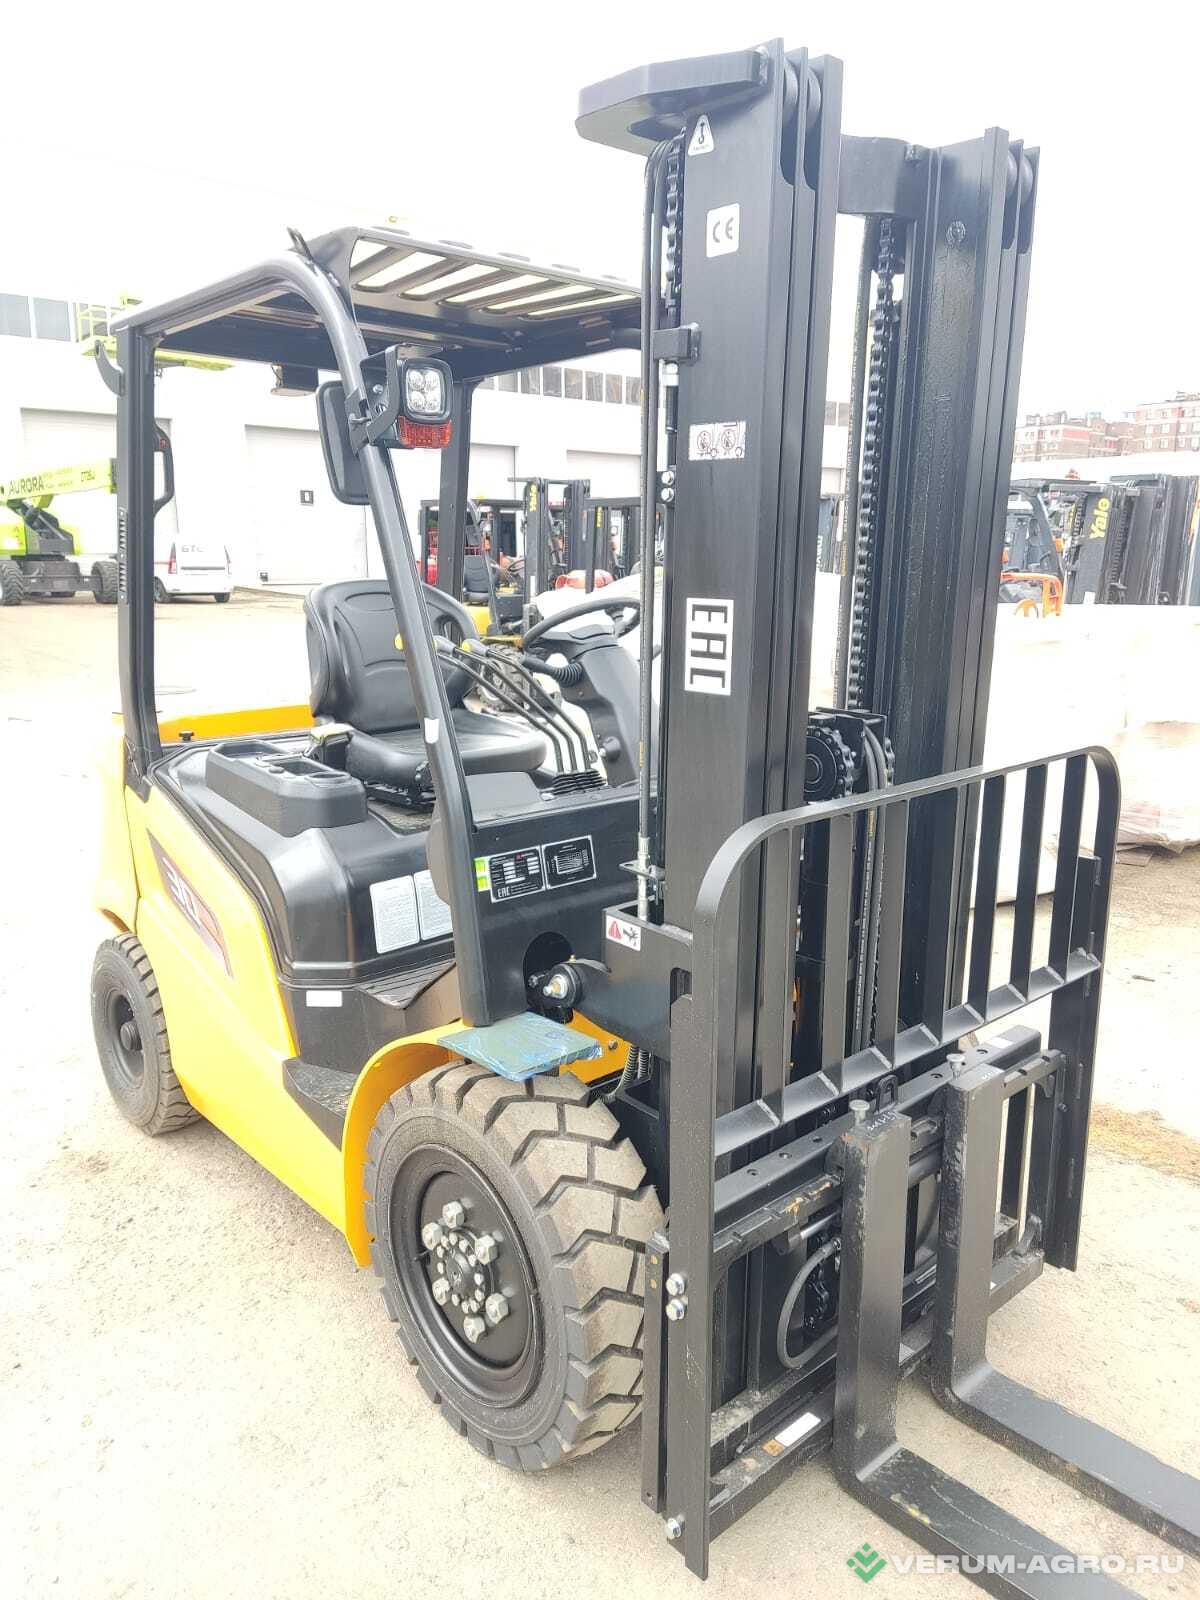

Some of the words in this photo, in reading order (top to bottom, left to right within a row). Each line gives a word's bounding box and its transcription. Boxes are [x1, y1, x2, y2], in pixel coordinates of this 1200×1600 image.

[712, 216, 734, 243] CE
[8, 474, 45, 496] AURORA
[1089, 497, 1110, 539] Yale
[497, 886, 511, 898] EAC
